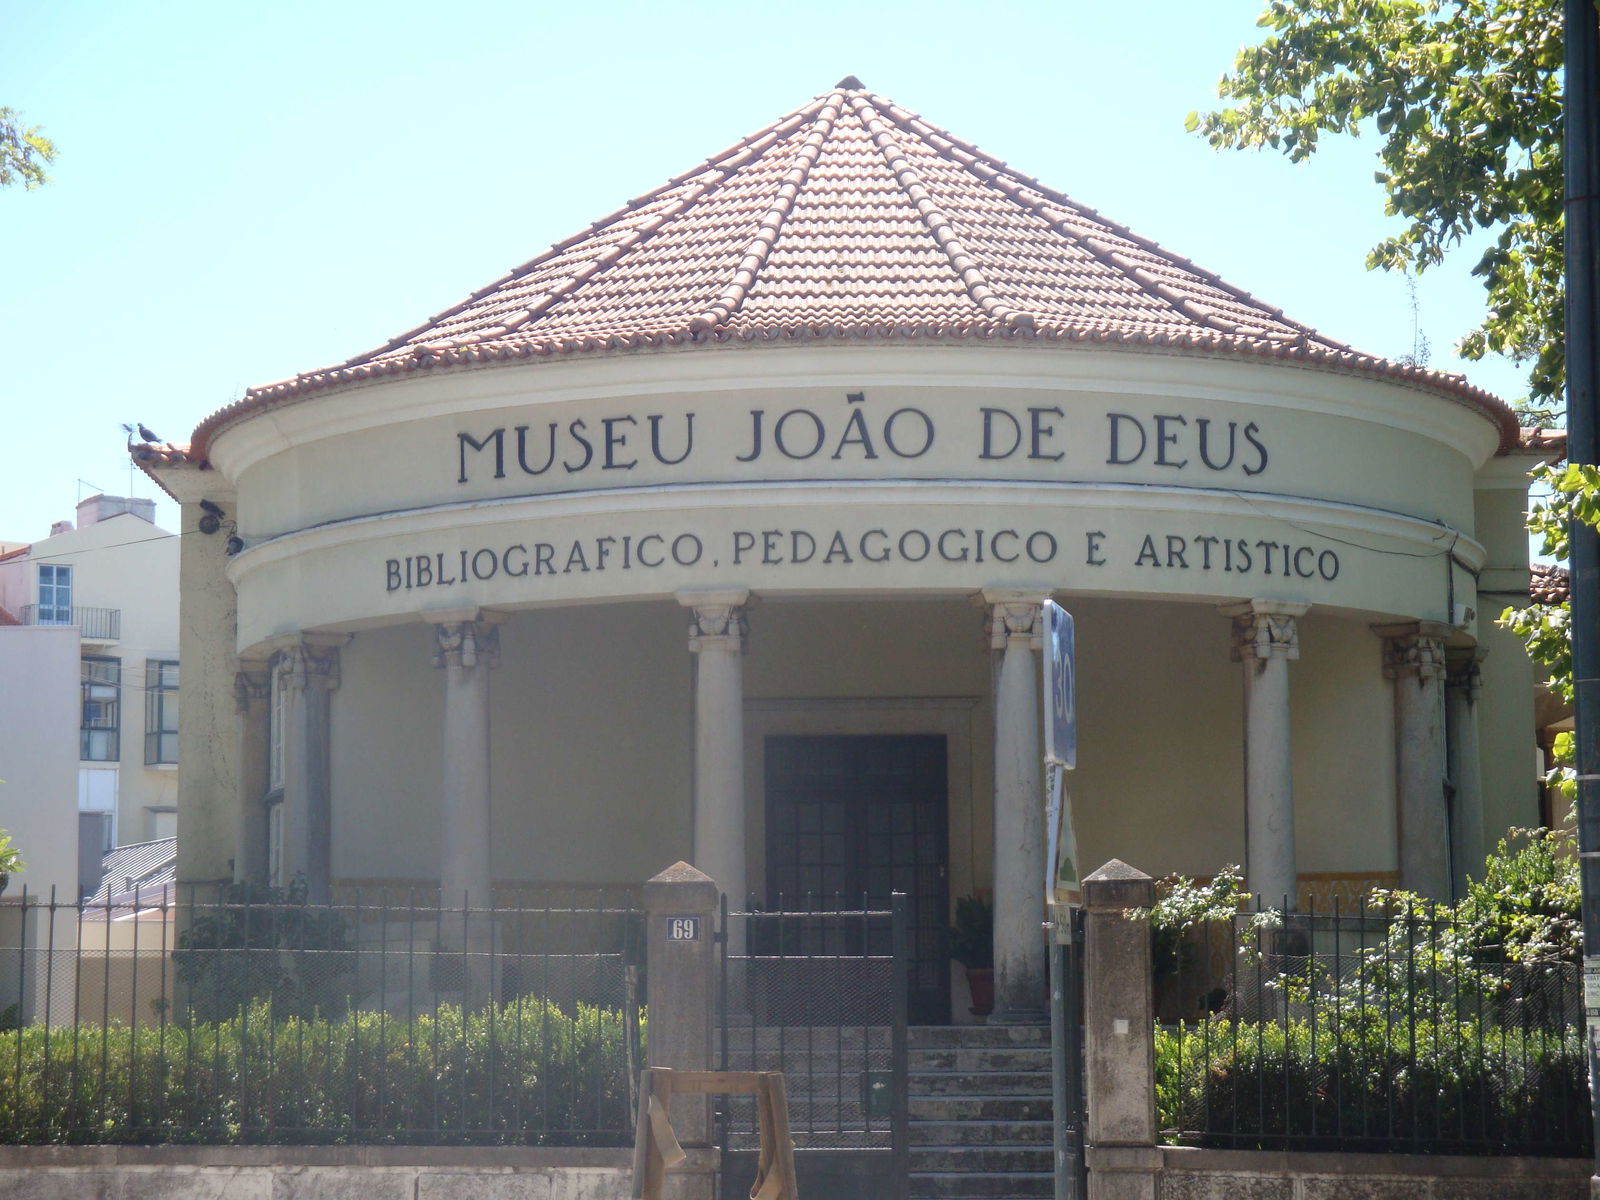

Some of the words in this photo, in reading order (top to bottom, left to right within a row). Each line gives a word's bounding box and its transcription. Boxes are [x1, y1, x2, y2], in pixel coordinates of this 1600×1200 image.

[457, 412, 695, 483] MUSEU
[736, 391, 935, 462] JOÃO
[978, 406, 1065, 462] DE
[1106, 412, 1268, 477] DEUS
[733, 528, 1058, 565] PEDAGOGICO
[1086, 530, 1106, 566] E
[1134, 534, 1340, 581] ARTISTICO
[1055, 650, 1073, 724] 30
[673, 919, 694, 939] 69
